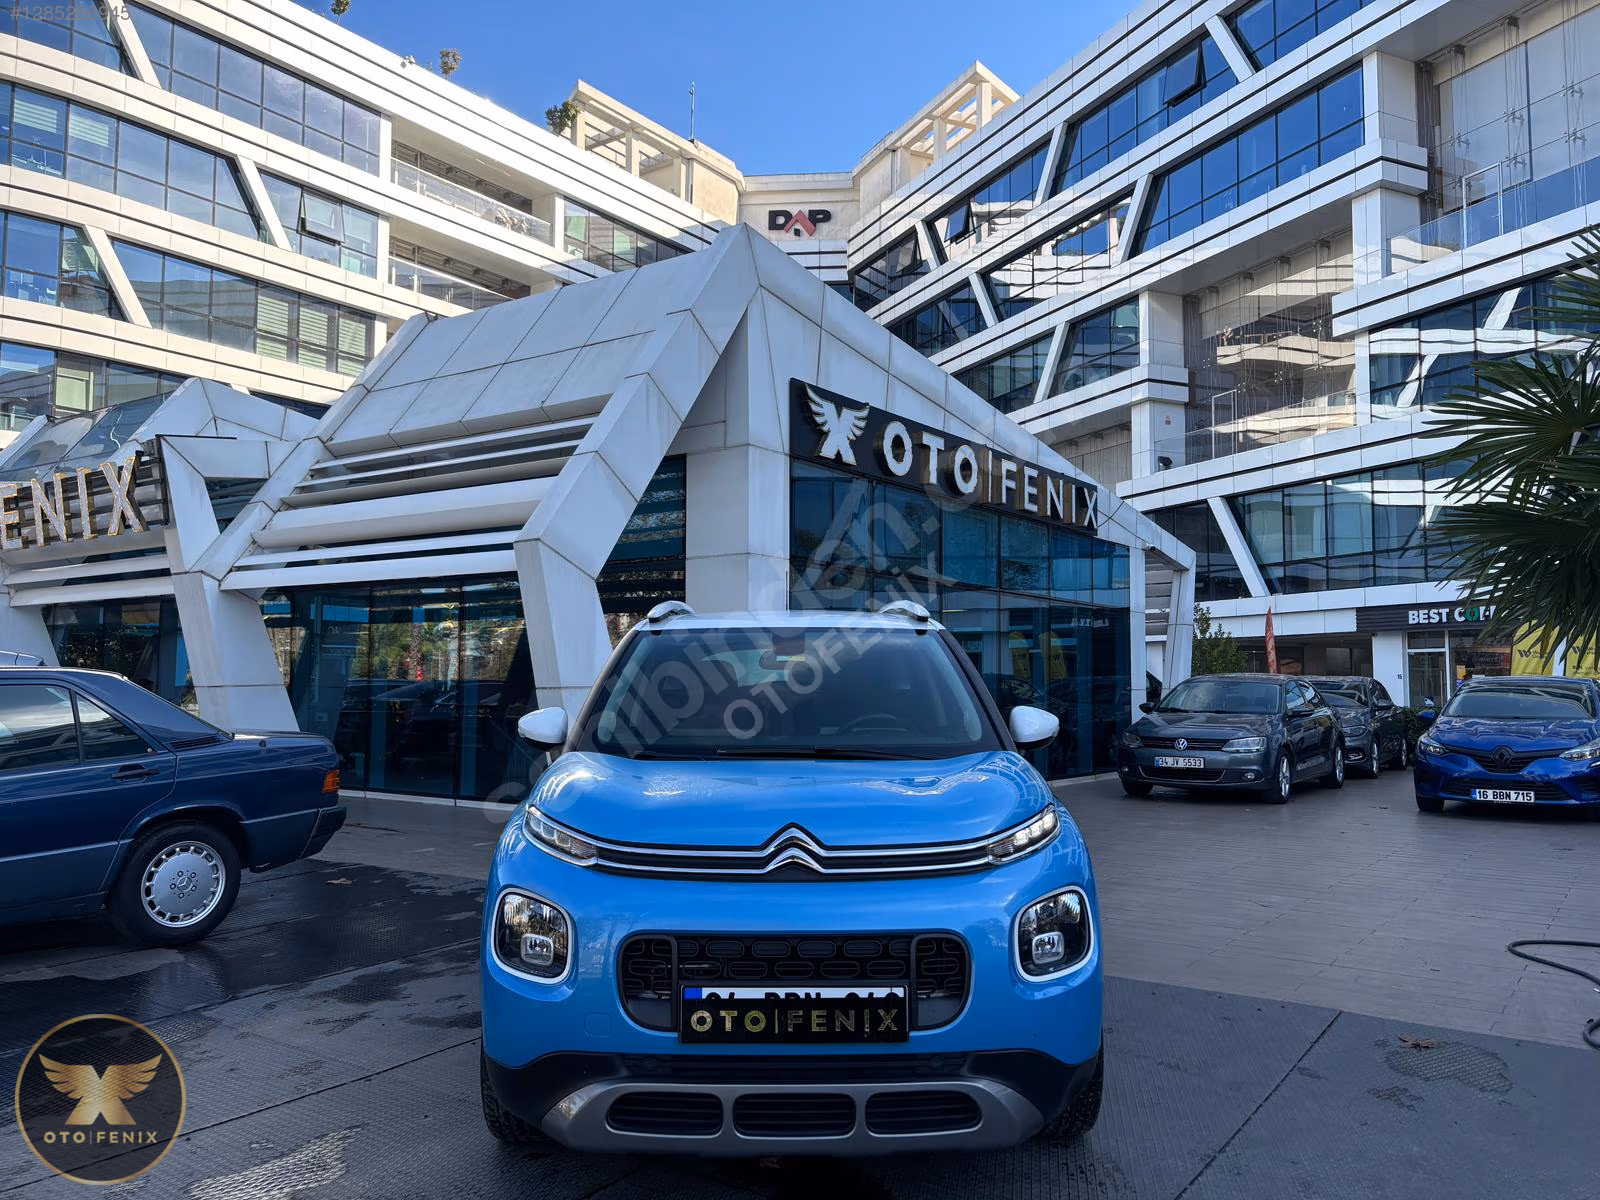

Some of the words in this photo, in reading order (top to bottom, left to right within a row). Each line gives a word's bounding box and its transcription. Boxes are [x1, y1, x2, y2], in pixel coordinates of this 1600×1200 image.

[768, 209, 832, 237] DAP
[1408, 608, 1450, 625] BEST
[1477, 790, 1489, 799] 16
[1492, 790, 1512, 800] BBN
[1514, 791, 1532, 802] 715
